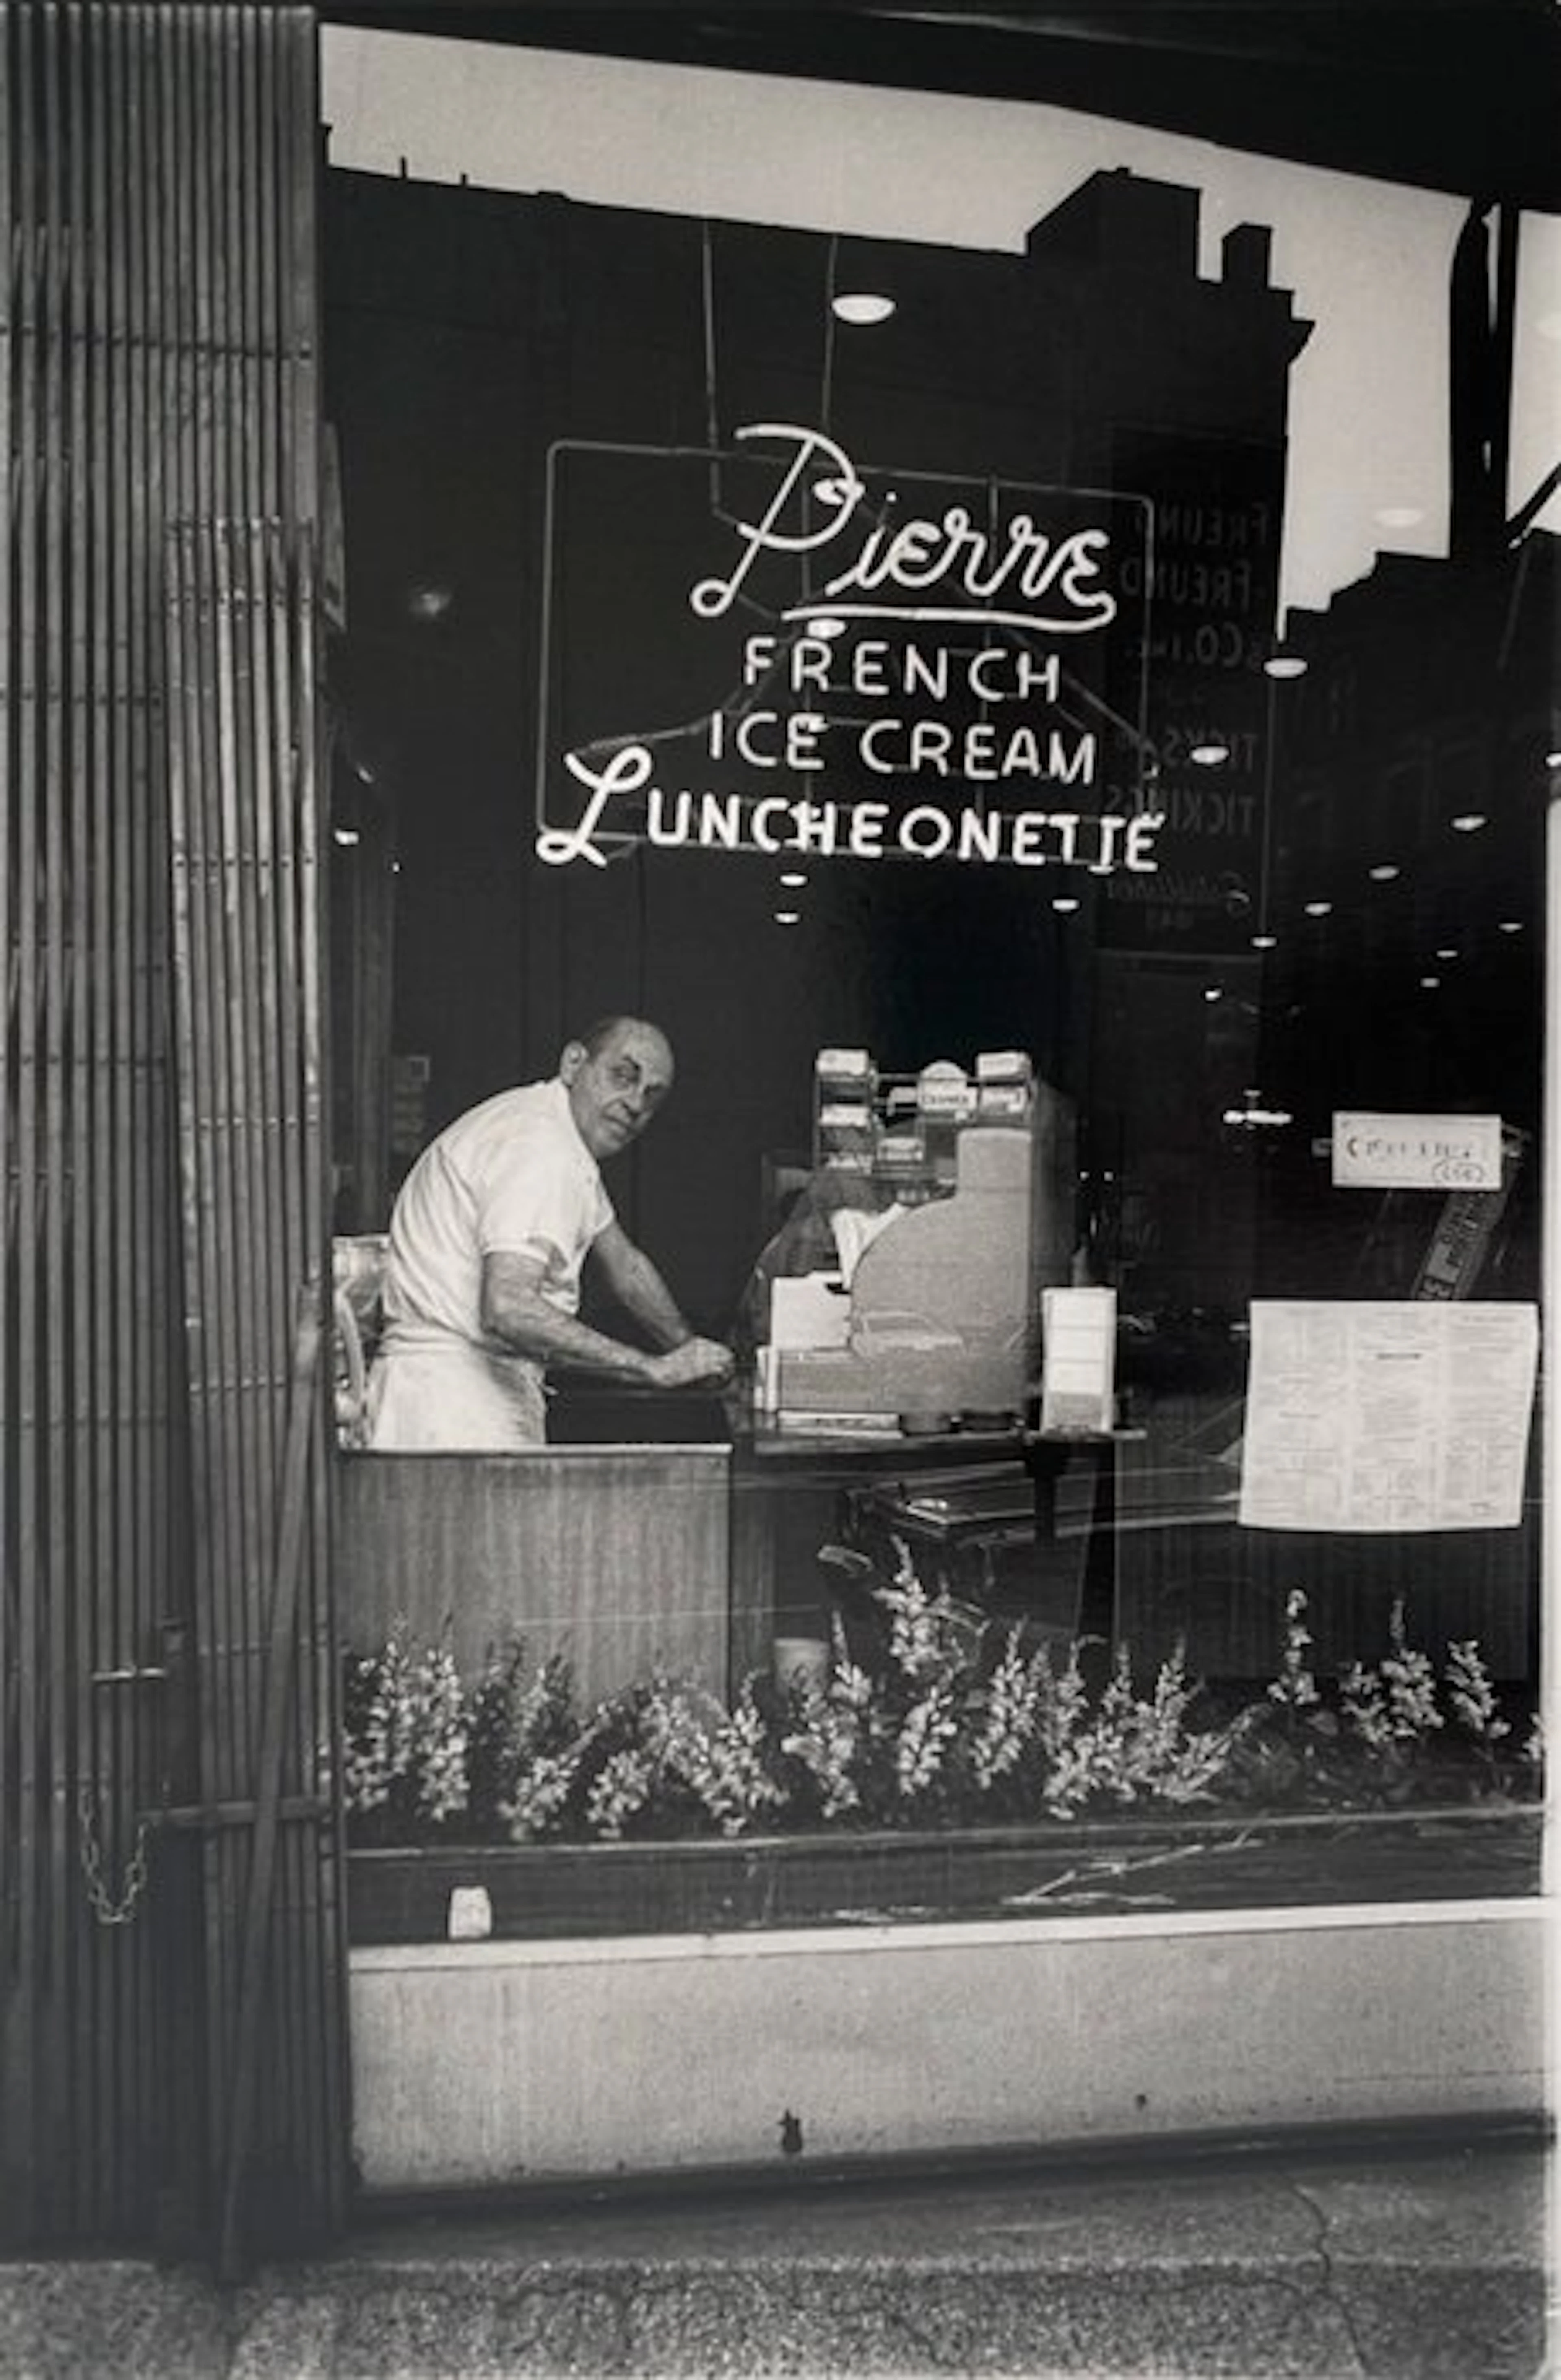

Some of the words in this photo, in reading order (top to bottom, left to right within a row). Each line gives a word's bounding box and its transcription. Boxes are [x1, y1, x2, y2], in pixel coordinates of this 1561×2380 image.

[690, 424, 1116, 632] Pierre
[745, 637, 1059, 702] FRENCH
[711, 711, 826, 769] ICE
[860, 719, 1094, 784] CREAM
[535, 745, 1165, 874] LUNCHEONETTE
